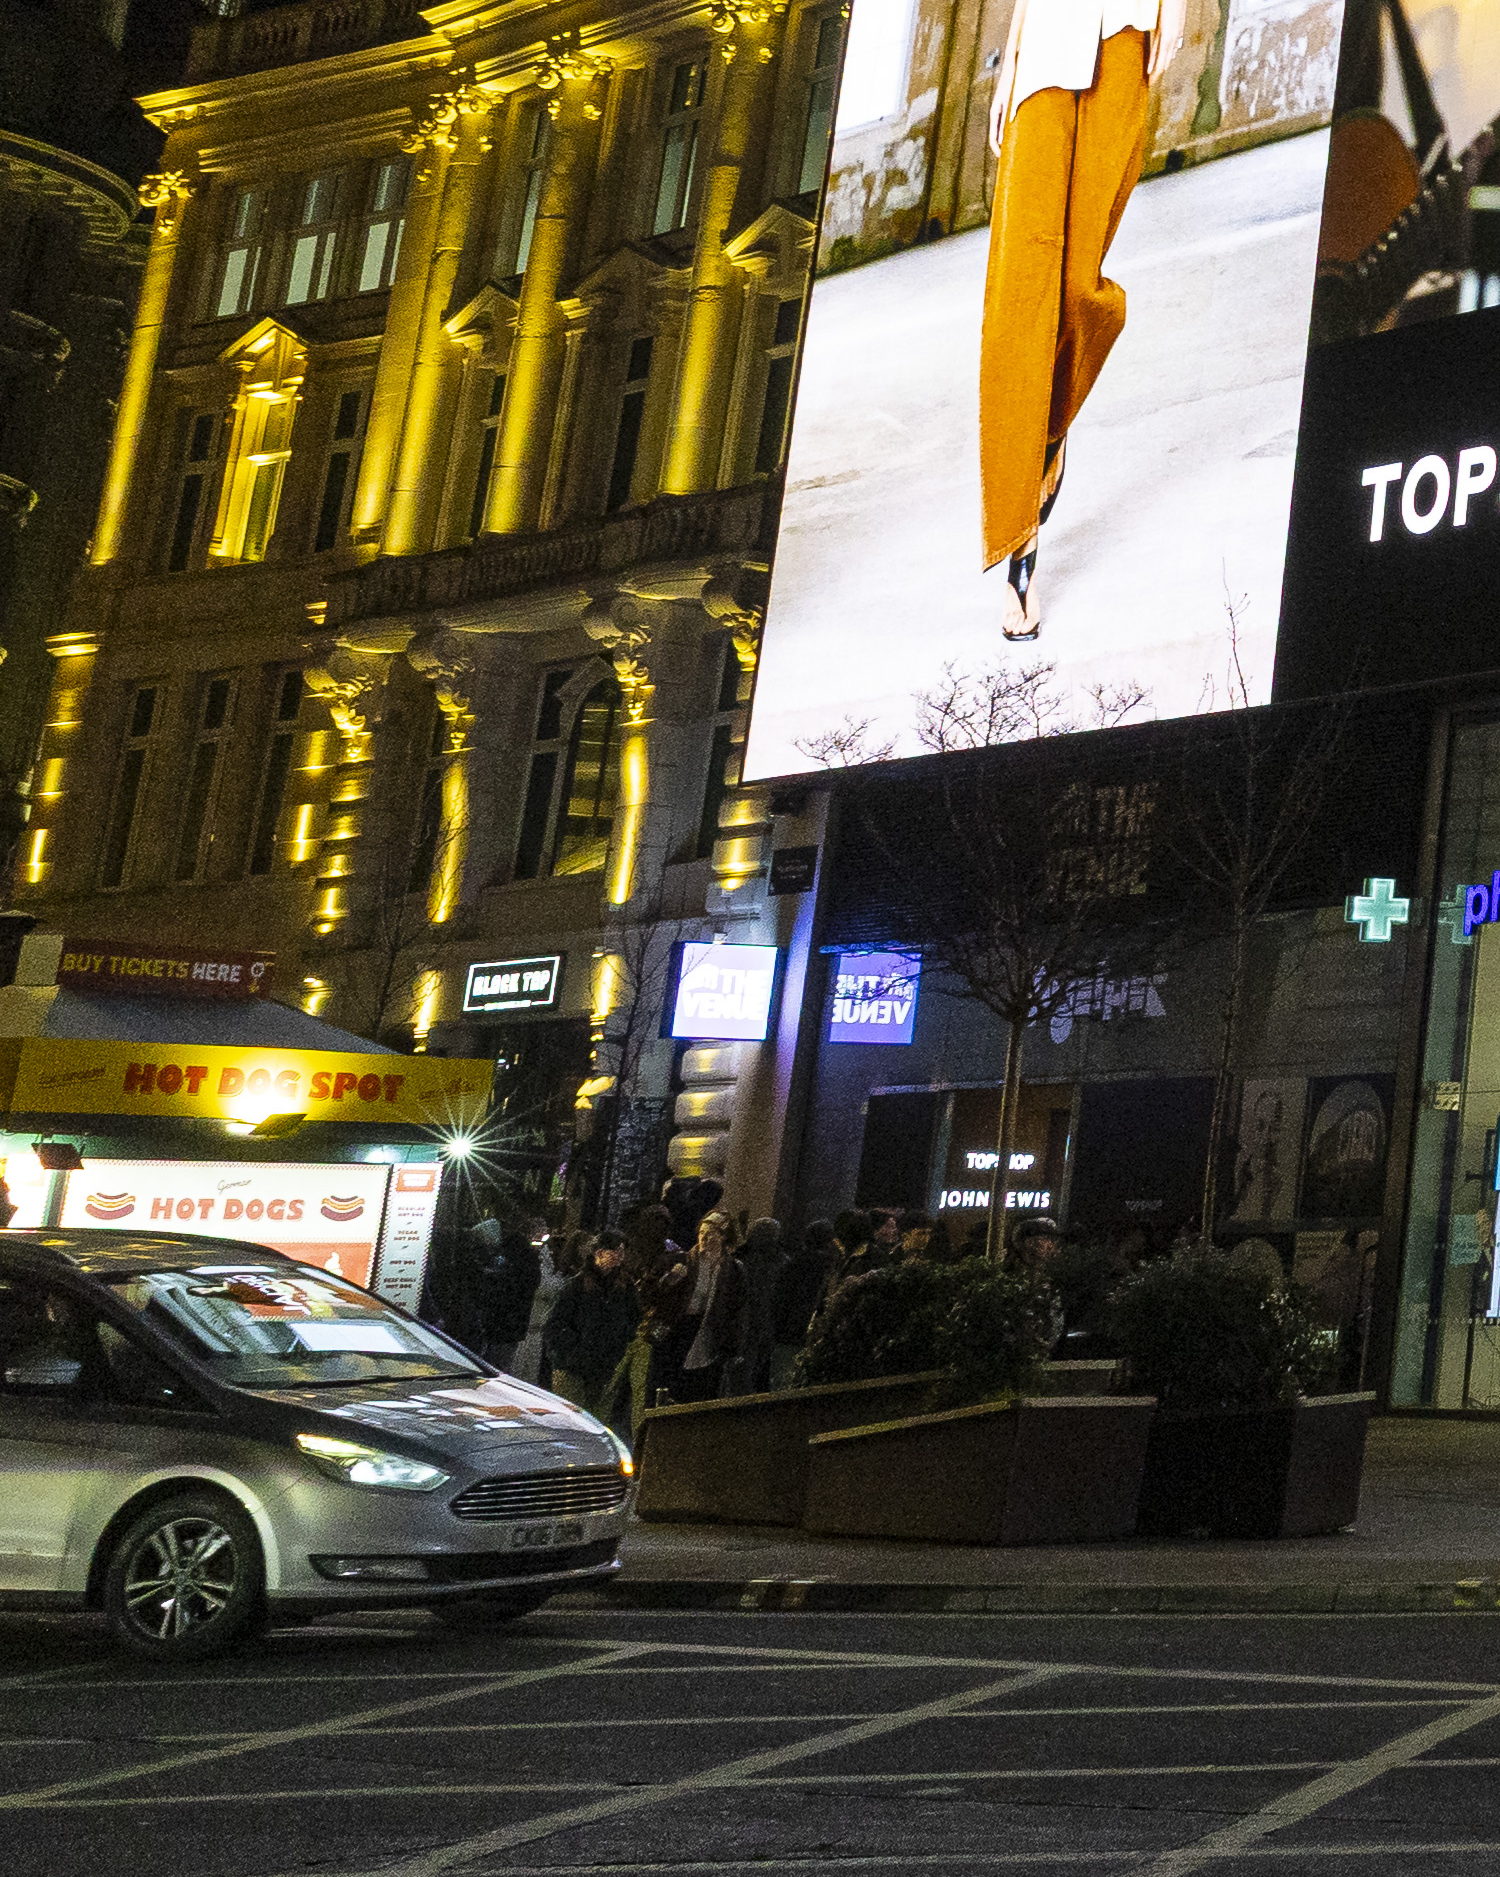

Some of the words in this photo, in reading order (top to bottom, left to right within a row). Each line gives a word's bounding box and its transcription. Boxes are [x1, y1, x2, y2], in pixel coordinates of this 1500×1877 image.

[63, 953, 104, 973] BUY
[109, 955, 190, 979] TICKETS
[192, 961, 243, 983] HERE
[683, 991, 765, 1021] VENUE
[123, 1062, 208, 1096] HOT
[217, 1066, 302, 1100] DOG
[308, 1071, 405, 1103] SPOT
[966, 1151, 1036, 1171] TOPOP
[149, 1196, 216, 1221] HOT
[222, 1198, 307, 1222] DOGS
[938, 1189, 991, 1210] JOHN
[1004, 1190, 1051, 1209] EWIS
